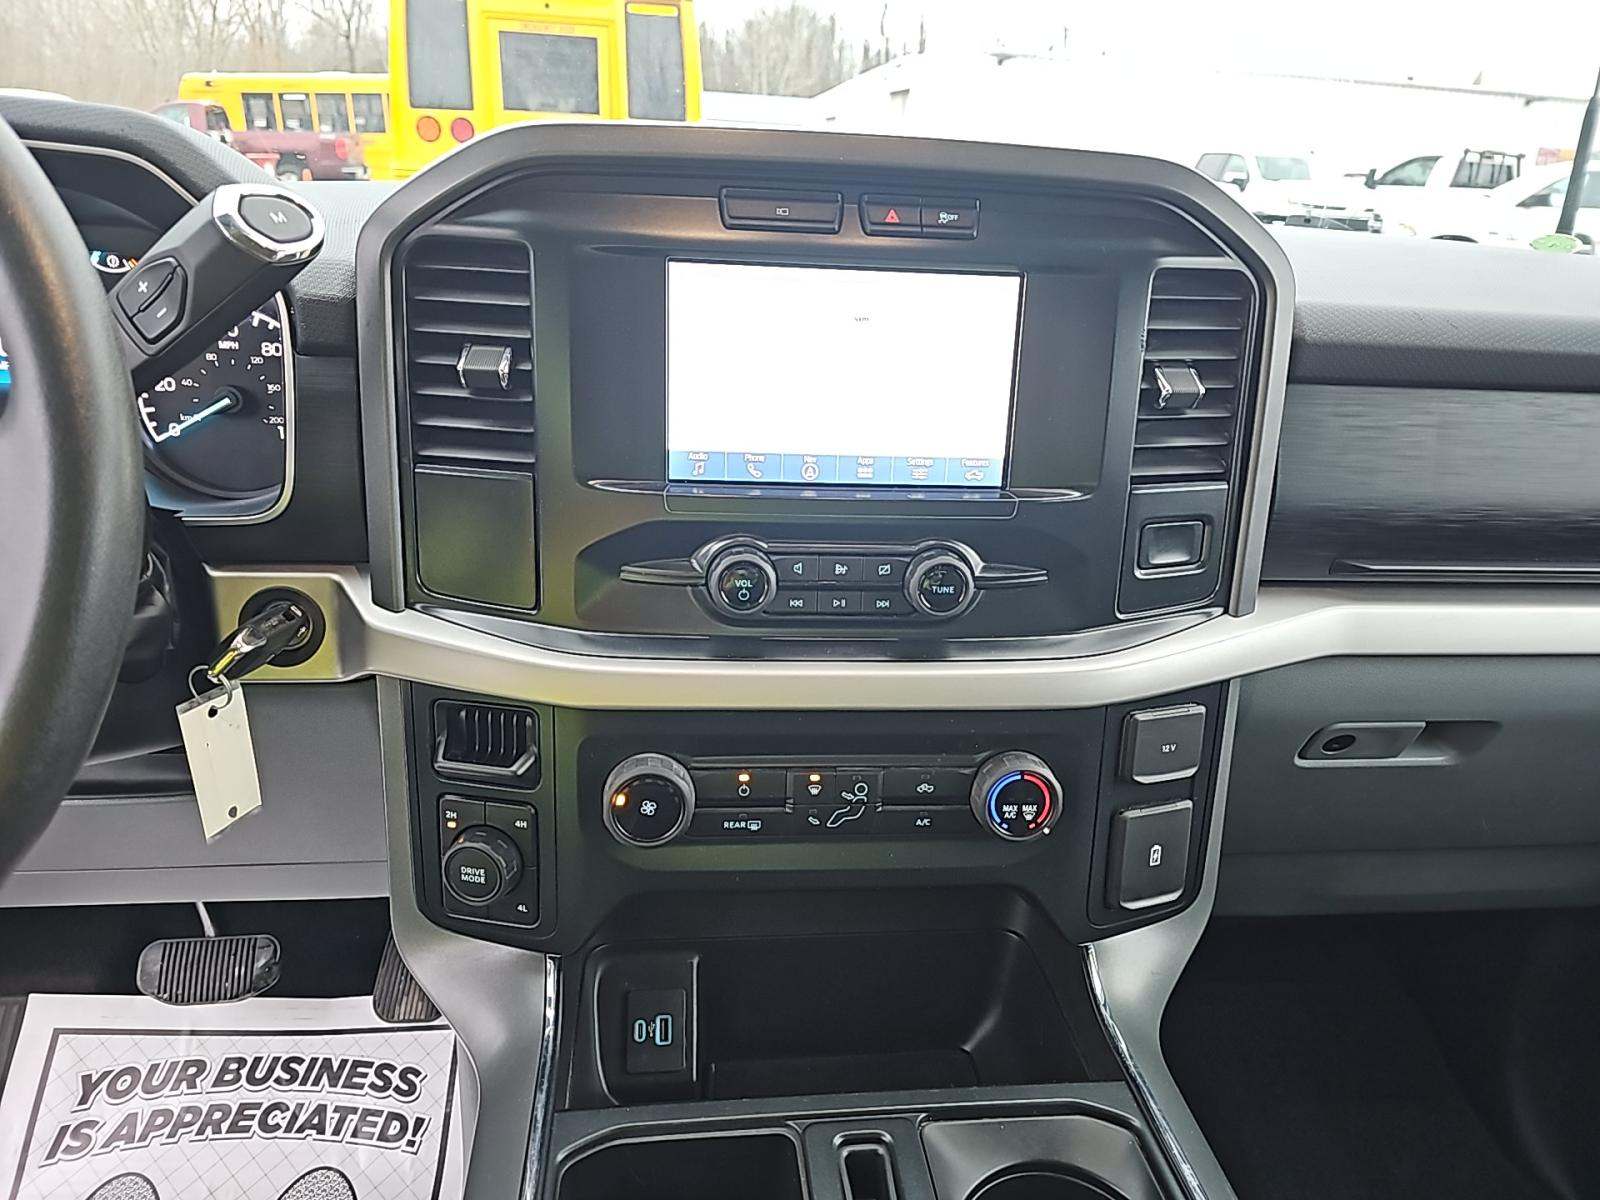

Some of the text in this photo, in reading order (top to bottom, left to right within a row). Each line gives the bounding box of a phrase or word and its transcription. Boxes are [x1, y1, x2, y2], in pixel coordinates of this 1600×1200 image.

[269, 211, 287, 225] M
[218, 341, 239, 350] MPH
[261, 341, 282, 357] 80
[250, 356, 264, 364] 120
[182, 378, 193, 386] 40
[267, 384, 281, 392] 160
[268, 416, 285, 424] 200
[688, 451, 709, 461] Audio
[744, 453, 766, 463] Phone
[857, 456, 874, 466] Apps
[906, 457, 934, 467] Settings
[961, 458, 990, 468] Features
[734, 579, 753, 588] VOL
[932, 585, 955, 594] TUNE
[1002, 804, 1018, 812] MAX
[1022, 804, 1037, 812] MAX
[445, 810, 457, 819] 2H
[1004, 811, 1017, 819] A/C
[514, 820, 528, 829] 4H
[723, 821, 746, 829] REAR
[916, 818, 931, 826] A/C
[460, 866, 485, 876] DRIVE
[461, 874, 486, 884] MODE
[517, 904, 528, 913] 4L
[74, 1054, 427, 1110] YOUR BUSINESS
[43, 1099, 429, 1163] IS APPRECIATED!
